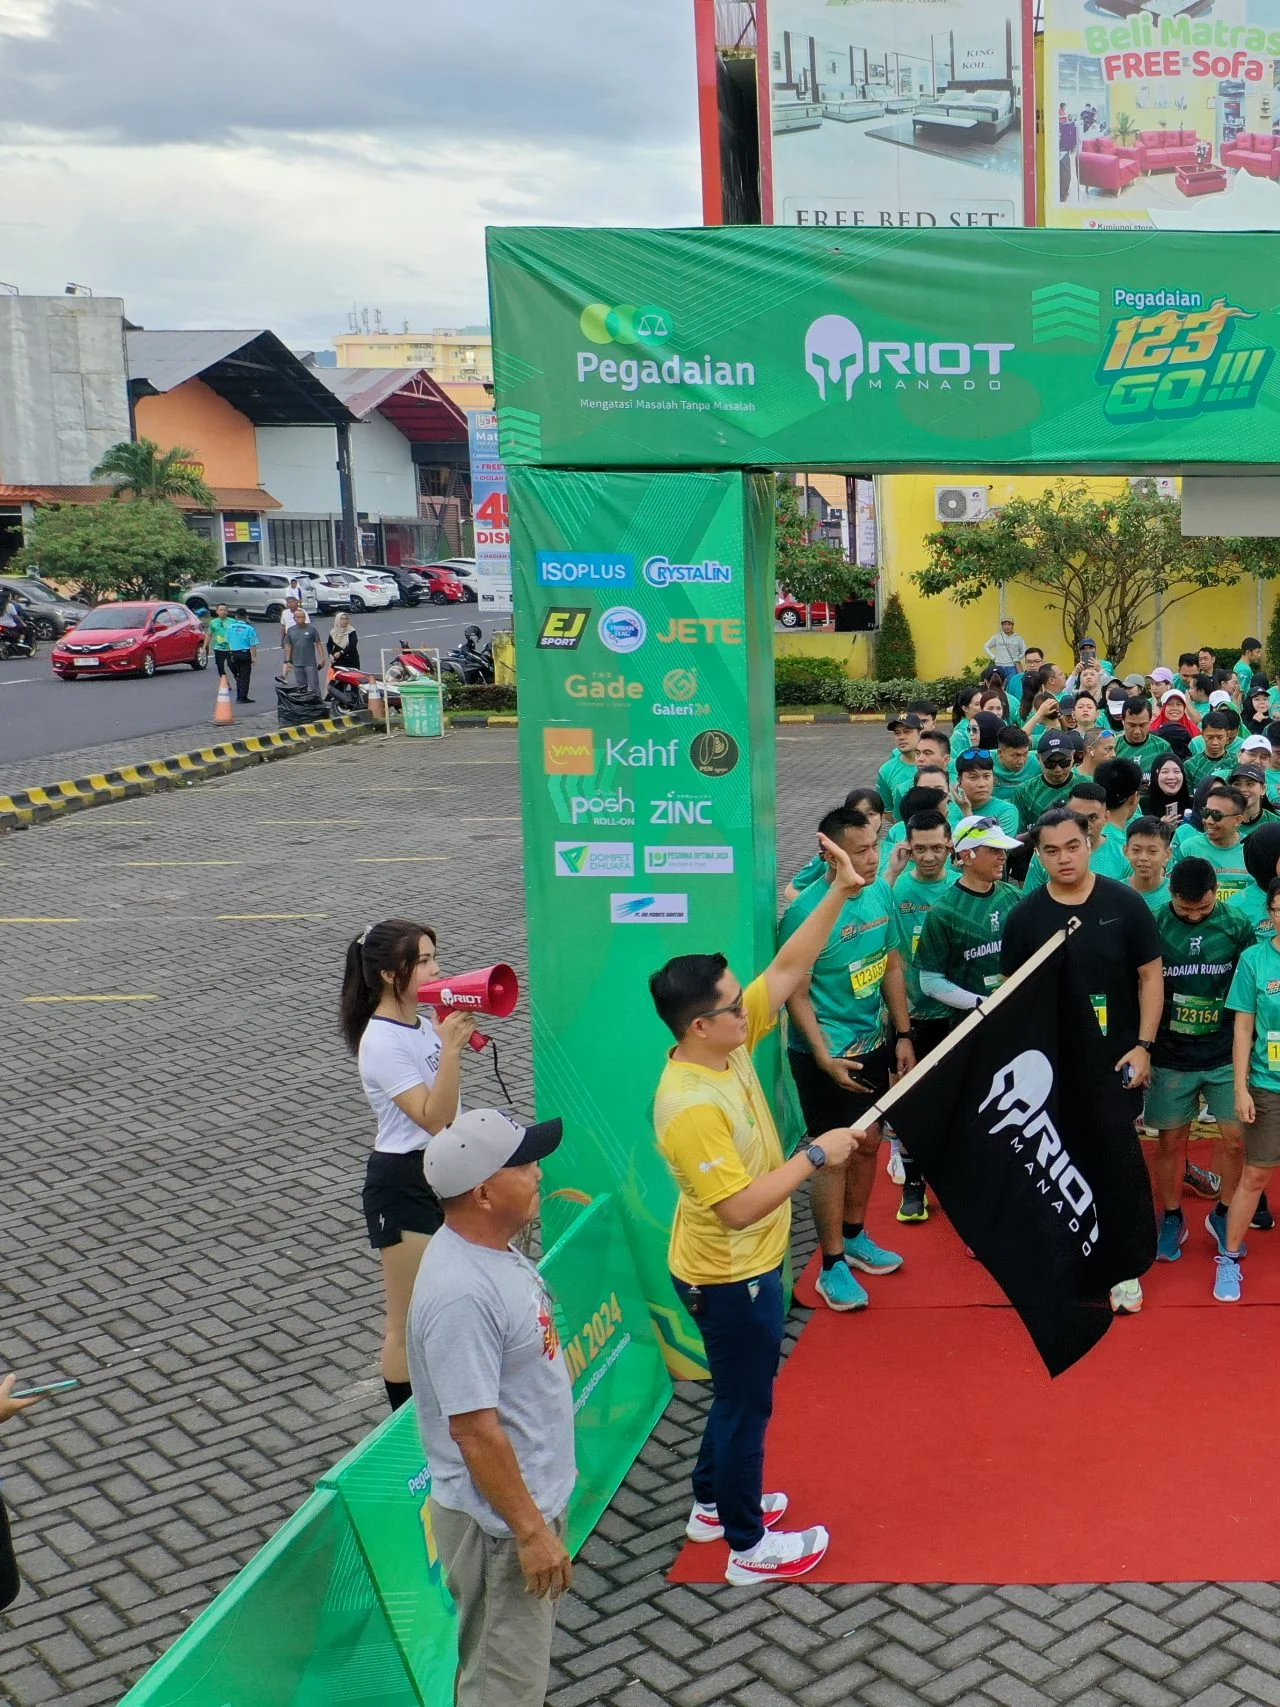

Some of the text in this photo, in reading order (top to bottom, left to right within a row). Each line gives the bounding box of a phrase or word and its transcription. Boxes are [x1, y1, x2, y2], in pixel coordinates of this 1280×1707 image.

[1085, 13, 1151, 54] Beli
[1104, 51, 1264, 81] FREE Sofa
[1115, 290, 1200, 310] Pegadaian
[1103, 303, 1230, 371] 123
[577, 351, 756, 391] Pegadaian
[868, 342, 1015, 375] RIOT
[870, 379, 1001, 391] MANADO
[580, 398, 756, 413] Mengatasi Masalah Tanpa Masalah
[542, 562, 626, 581] ISOPLUS
[544, 613, 586, 638] EJ
[657, 618, 742, 644] JETE
[541, 637, 576, 647] SPORT
[565, 674, 644, 699] Gade
[606, 738, 680, 767] Kahf
[571, 786, 635, 824] posh
[650, 800, 712, 824] ZINC
[593, 817, 635, 826] ROLL-ON
[1162, 963, 1199, 977] GADAIAN
[453, 994, 482, 1005] RIOT
[1176, 1007, 1219, 1024] 123154
[1010, 1136, 1092, 1257] MANADO
[582, 1291, 624, 1361] 2024
[735, 1560, 778, 1570] SALOMON
